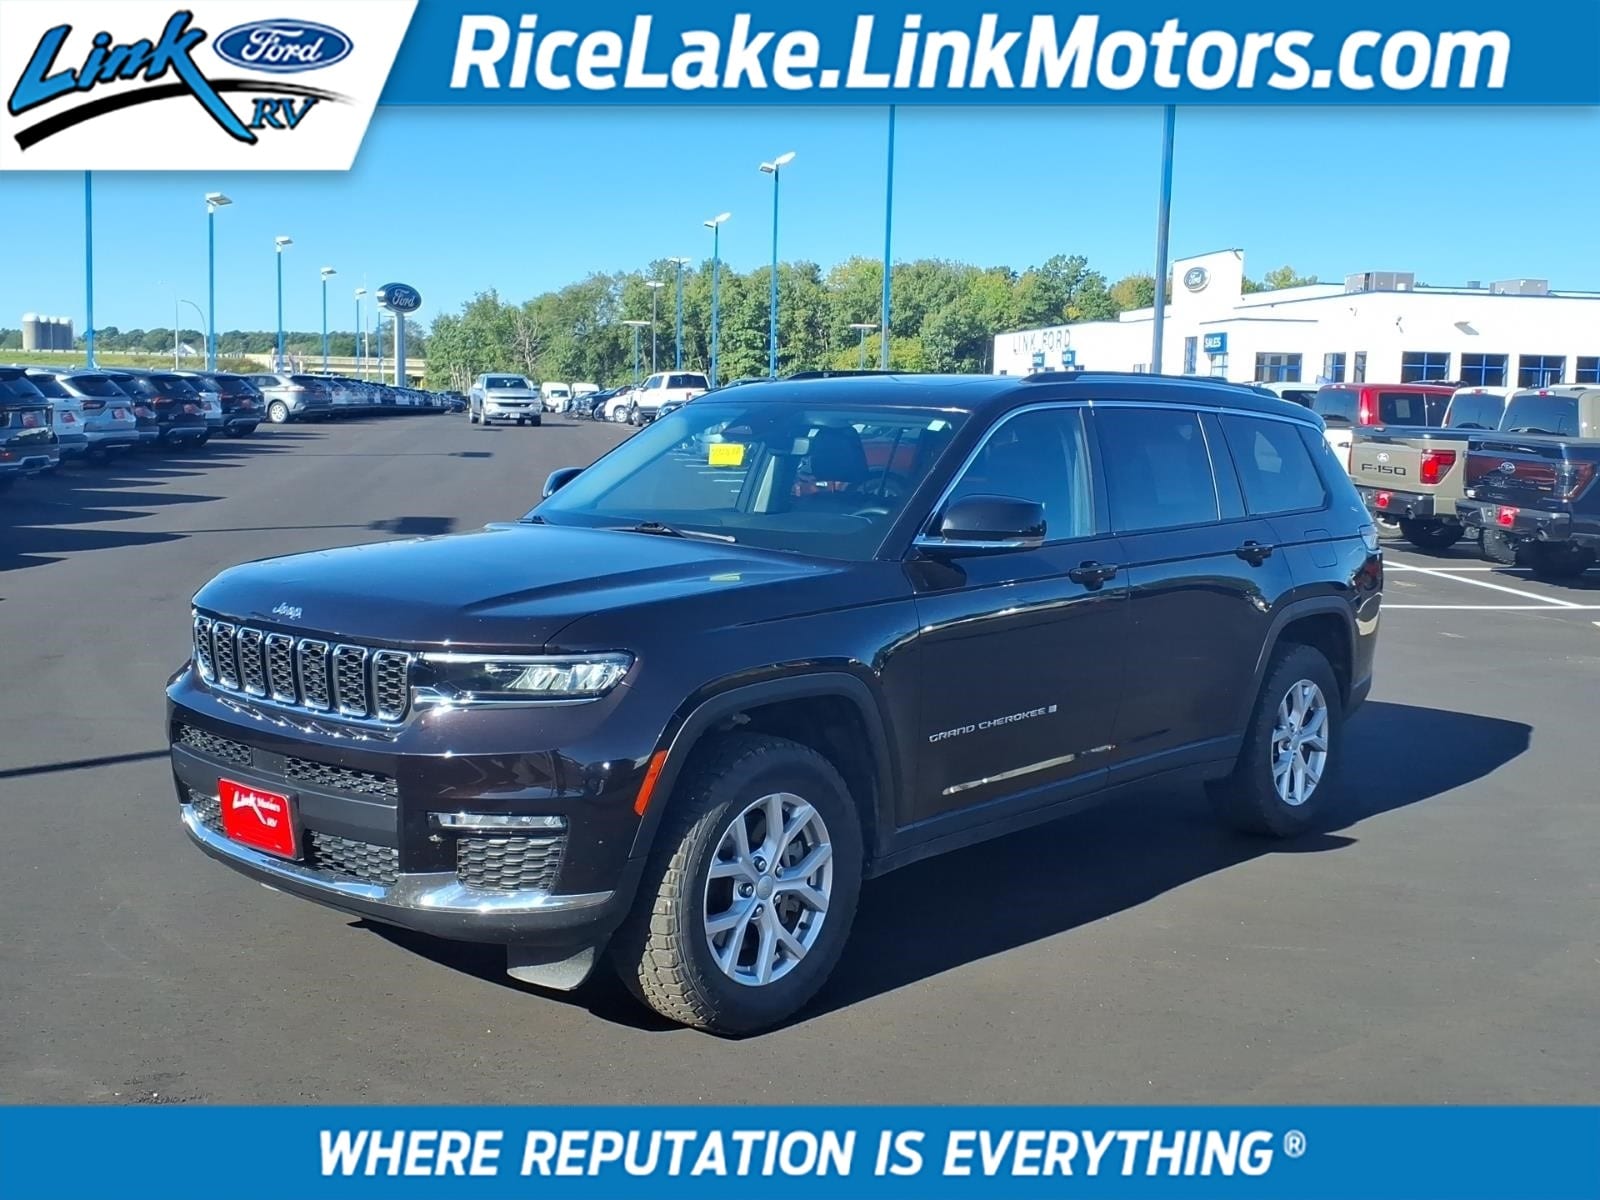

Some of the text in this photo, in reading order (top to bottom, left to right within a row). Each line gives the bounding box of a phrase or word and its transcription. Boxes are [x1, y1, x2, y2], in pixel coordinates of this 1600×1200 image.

[392, 288, 416, 307] Ford
[1013, 328, 1071, 355] LINK FORD
[1205, 336, 1222, 349] SALES
[1361, 463, 1407, 476] F-150
[272, 602, 303, 620] Jeep
[929, 724, 975, 743] GRAND
[978, 707, 1047, 729] CHEROKEE
[232, 791, 267, 825] Link
